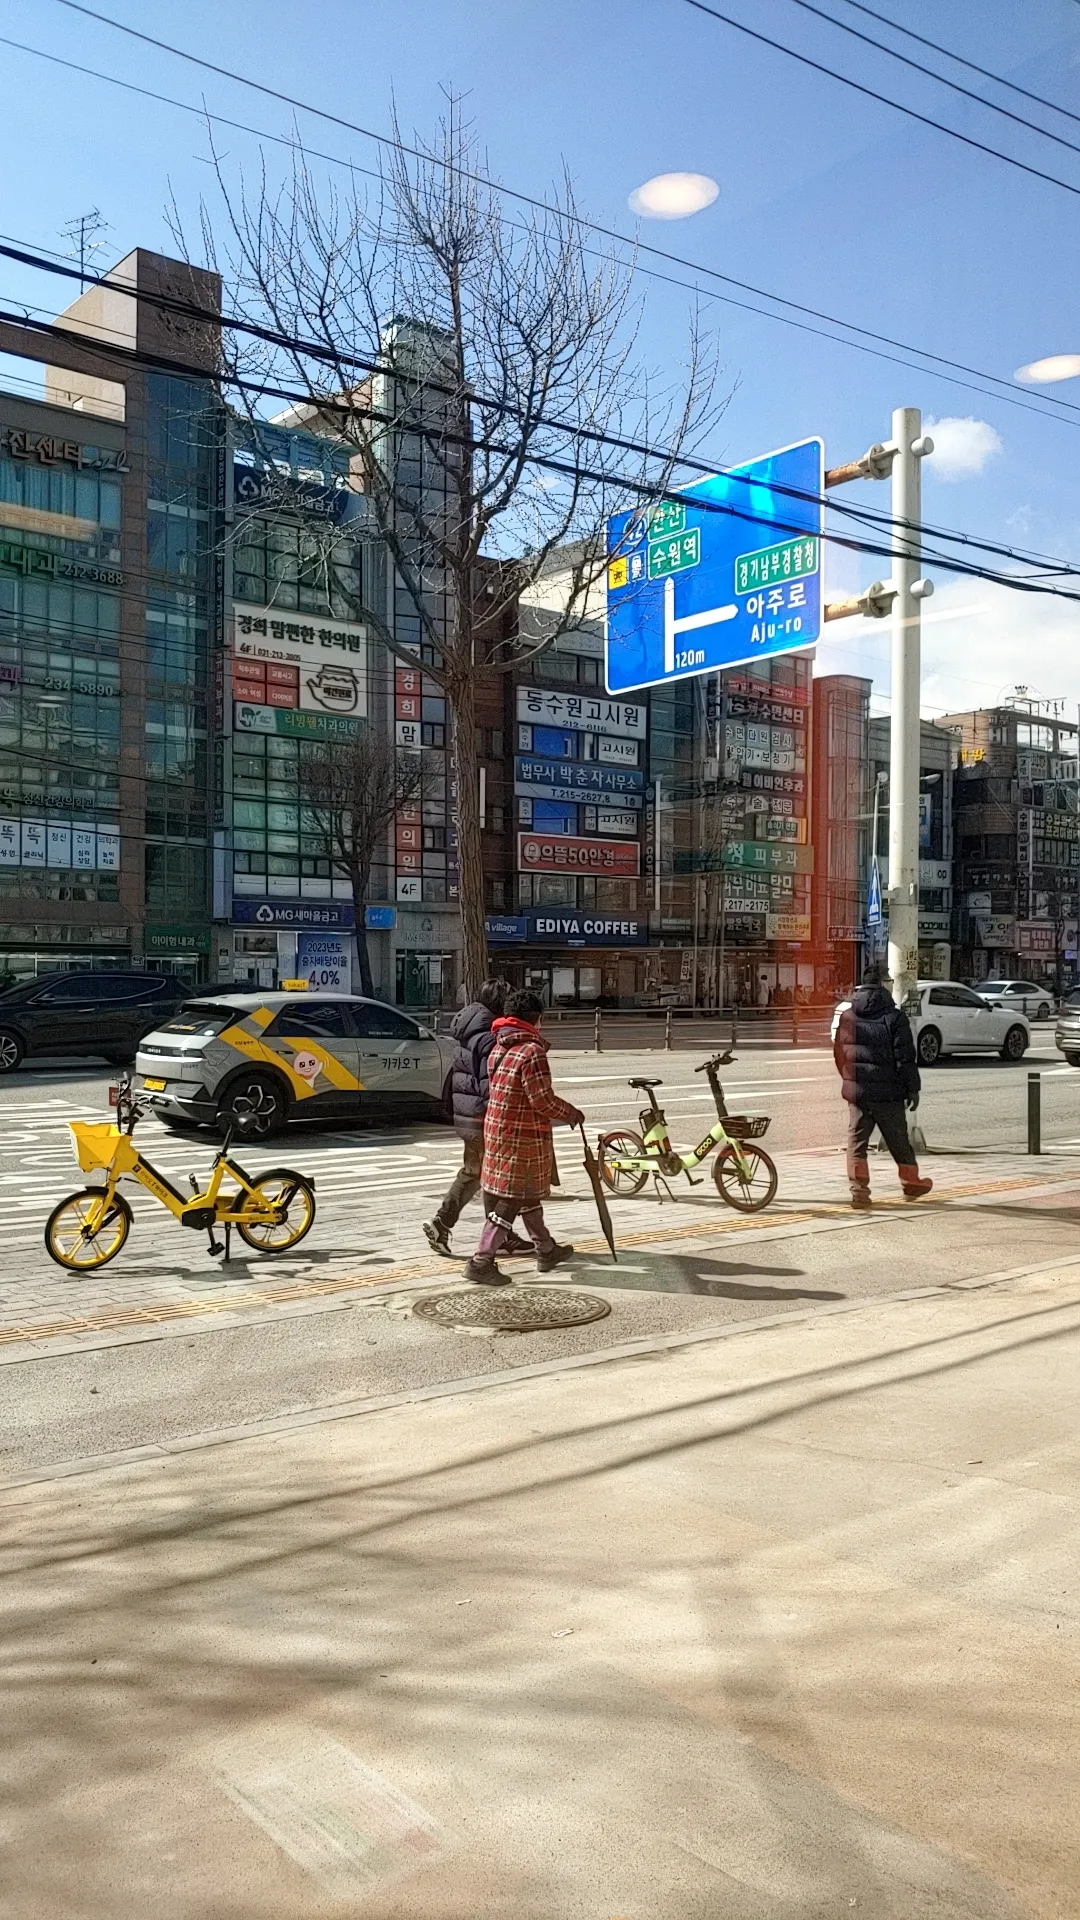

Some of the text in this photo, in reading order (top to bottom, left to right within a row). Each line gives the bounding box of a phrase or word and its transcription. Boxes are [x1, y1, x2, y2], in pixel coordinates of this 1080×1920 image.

[652, 535, 696, 569] 수원역
[739, 540, 815, 588] 경기남부경찰청
[64, 563, 124, 586] 212-3688
[746, 582, 807, 619] 아주로
[271, 620, 315, 645] 맘편한
[319, 628, 360, 653] 한의원
[751, 617, 802, 644] Aju-ro
[675, 650, 705, 669] 120m
[45, 677, 114, 696] 234-5890
[526, 690, 639, 728] 동수원고시원
[562, 719, 607, 733] 212-6116
[601, 742, 636, 756] 고시원
[521, 762, 556, 782] 법무사
[605, 774, 637, 791] 사무소
[754, 774, 804, 793] 이비인후과
[51, 832, 67, 843] 정신
[76, 834, 92, 844] 건강
[755, 848, 798, 868] 피부과
[401, 884, 417, 896] 4F
[275, 910, 339, 923] MG새마을금고
[492, 922, 517, 934] village
[536, 918, 638, 935] EDIYA COFFEE
[307, 943, 342, 953] 2023년도
[302, 955, 348, 968] 출자배당이율
[308, 971, 340, 986] 4.0%
[382, 1058, 421, 1070] 카카오 T
